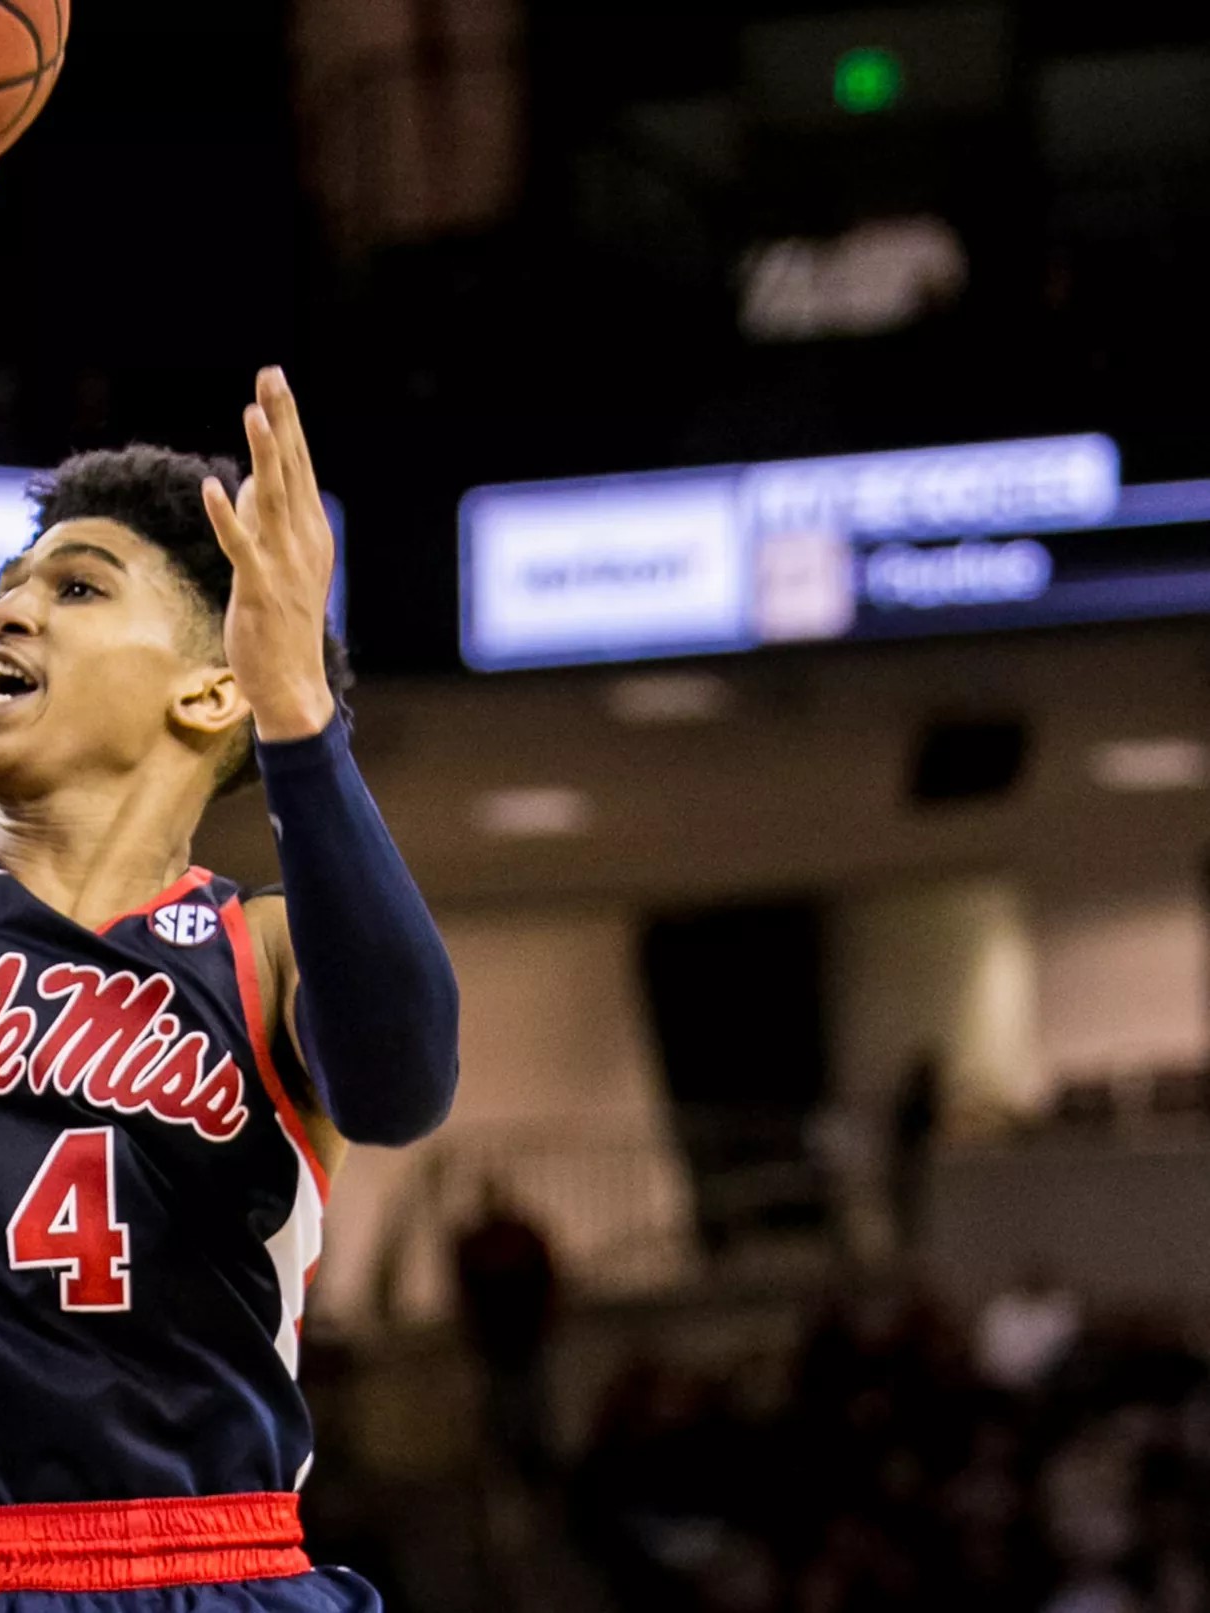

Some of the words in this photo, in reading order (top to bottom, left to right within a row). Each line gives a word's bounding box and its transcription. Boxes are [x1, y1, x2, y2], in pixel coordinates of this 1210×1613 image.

[153, 904, 218, 946] SEC
[28, 962, 250, 1142] Miss
[6, 1125, 132, 1313] 4
